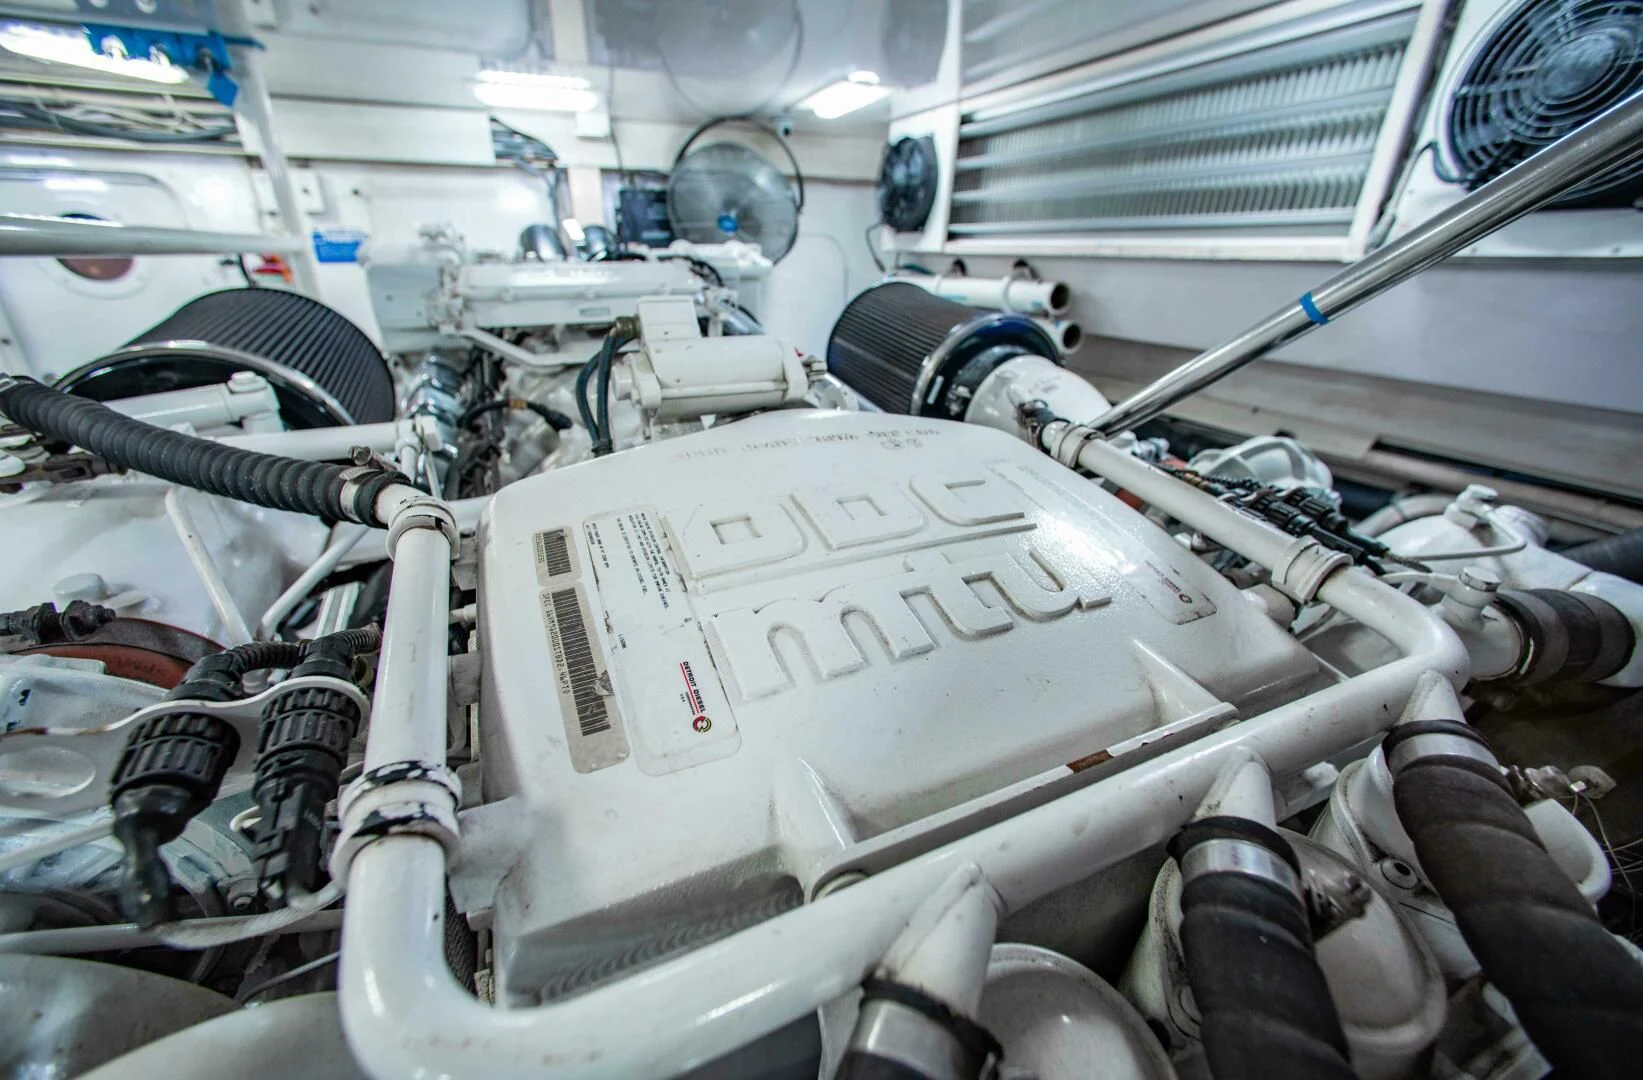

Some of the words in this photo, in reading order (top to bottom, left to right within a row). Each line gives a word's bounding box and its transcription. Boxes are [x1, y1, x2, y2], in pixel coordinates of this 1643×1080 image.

[711, 547, 1112, 701] mtu
[683, 661, 697, 687] DETROIT
[693, 689, 707, 714] DIESEL
